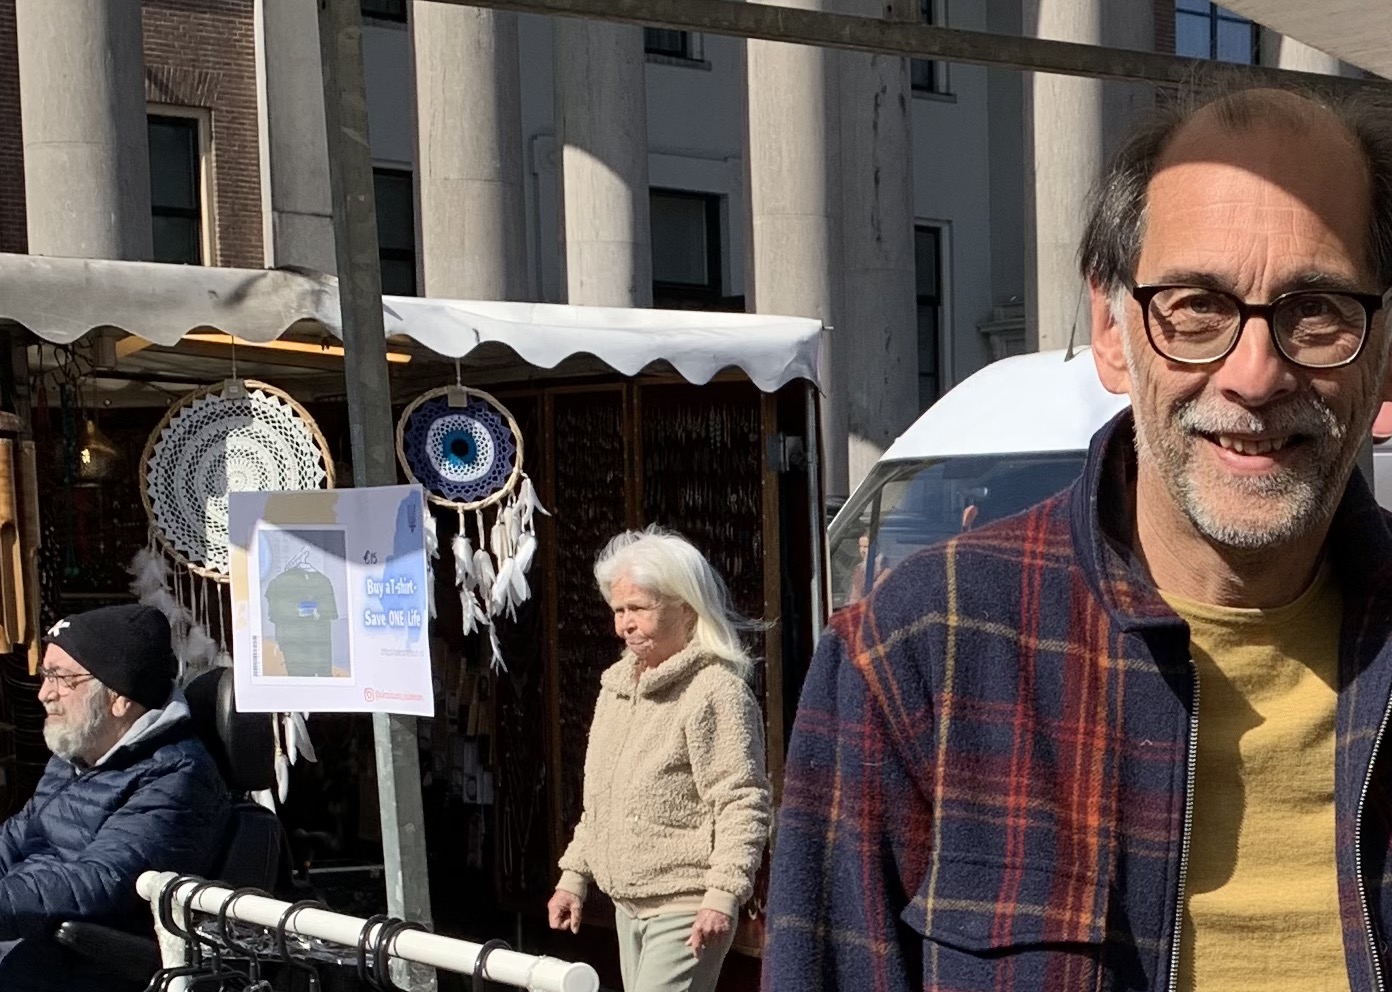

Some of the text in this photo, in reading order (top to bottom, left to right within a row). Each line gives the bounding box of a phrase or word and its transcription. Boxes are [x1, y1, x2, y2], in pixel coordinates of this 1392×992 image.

[366, 578, 384, 599] Buy
[364, 609, 421, 627] Save ONE Life
